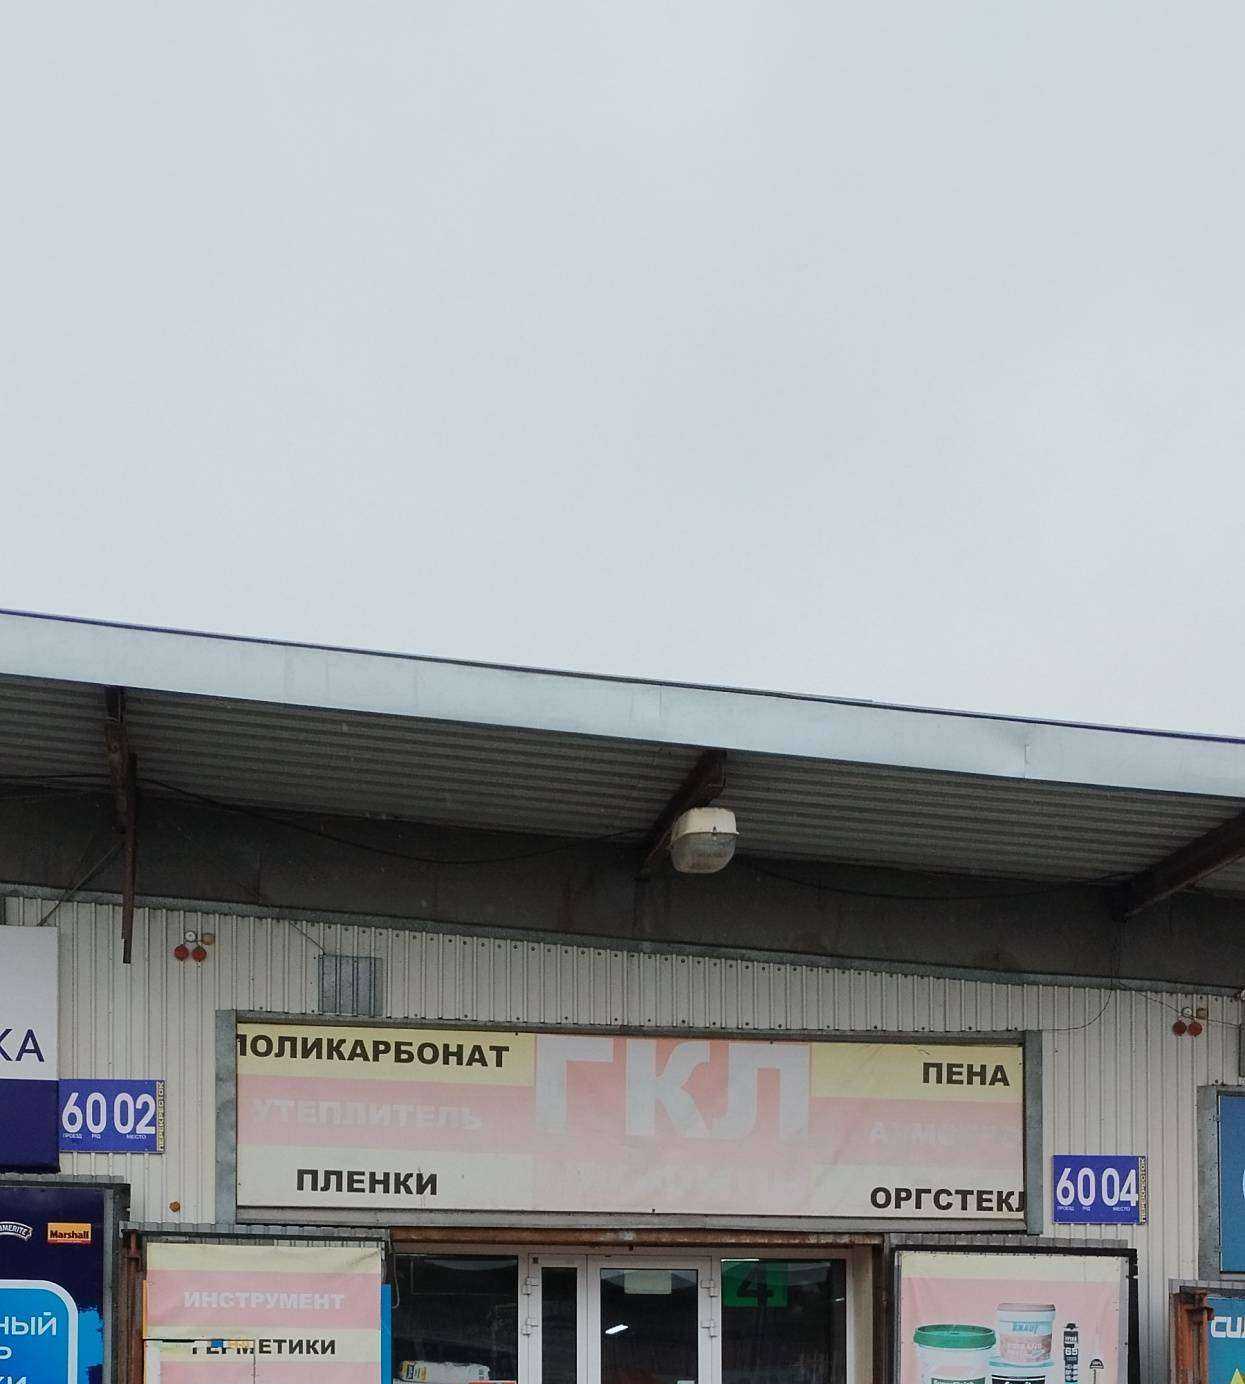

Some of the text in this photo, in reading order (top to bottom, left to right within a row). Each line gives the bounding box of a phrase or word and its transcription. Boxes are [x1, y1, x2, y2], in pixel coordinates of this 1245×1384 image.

[922, 1062, 1010, 1087] ПЕНА
[535, 1036, 810, 1139] ГКЛ
[253, 1098, 482, 1130] УТЕПЛИТЕЛЬ
[296, 1168, 438, 1196] ПЛЕНКИ
[49, 1230, 89, 1239] Marshall
[184, 1291, 345, 1310] ИНСТРУМЕНТ
[192, 1338, 336, 1355] ЕТИКИ
